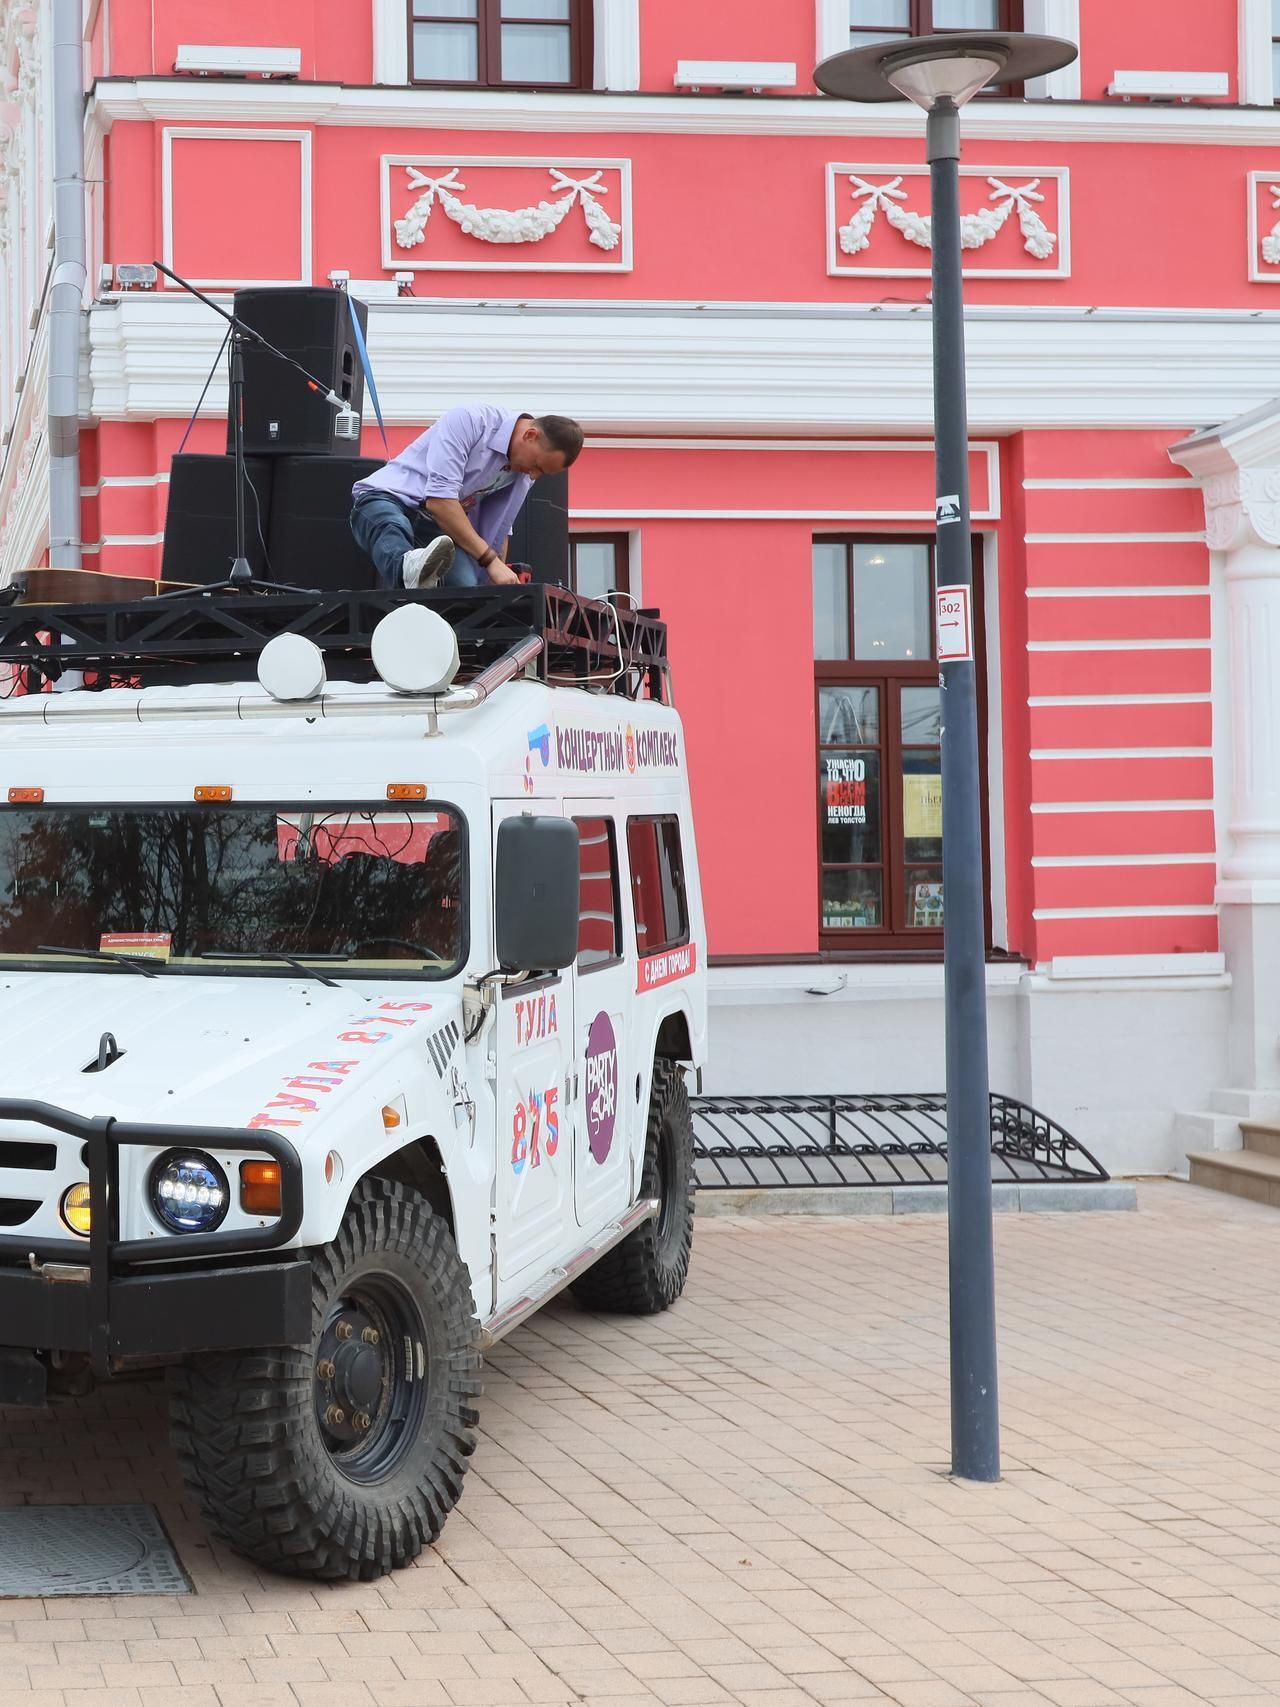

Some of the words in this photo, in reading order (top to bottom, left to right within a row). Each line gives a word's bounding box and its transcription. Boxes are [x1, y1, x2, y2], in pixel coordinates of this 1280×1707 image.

[941, 602, 961, 614] 302
[555, 723, 624, 773] КОНЦЕРТНЫЙ
[635, 729, 679, 767] КОМПЛЕКС
[827, 805, 866, 817] НЕКОГДА
[840, 816, 866, 824] ТОЛСТОЙ
[644, 961, 650, 983] С
[515, 992, 558, 1046] ТУЛА
[587, 1048, 616, 1094] PARTY
[246, 1061, 360, 1129] ТУЛА
